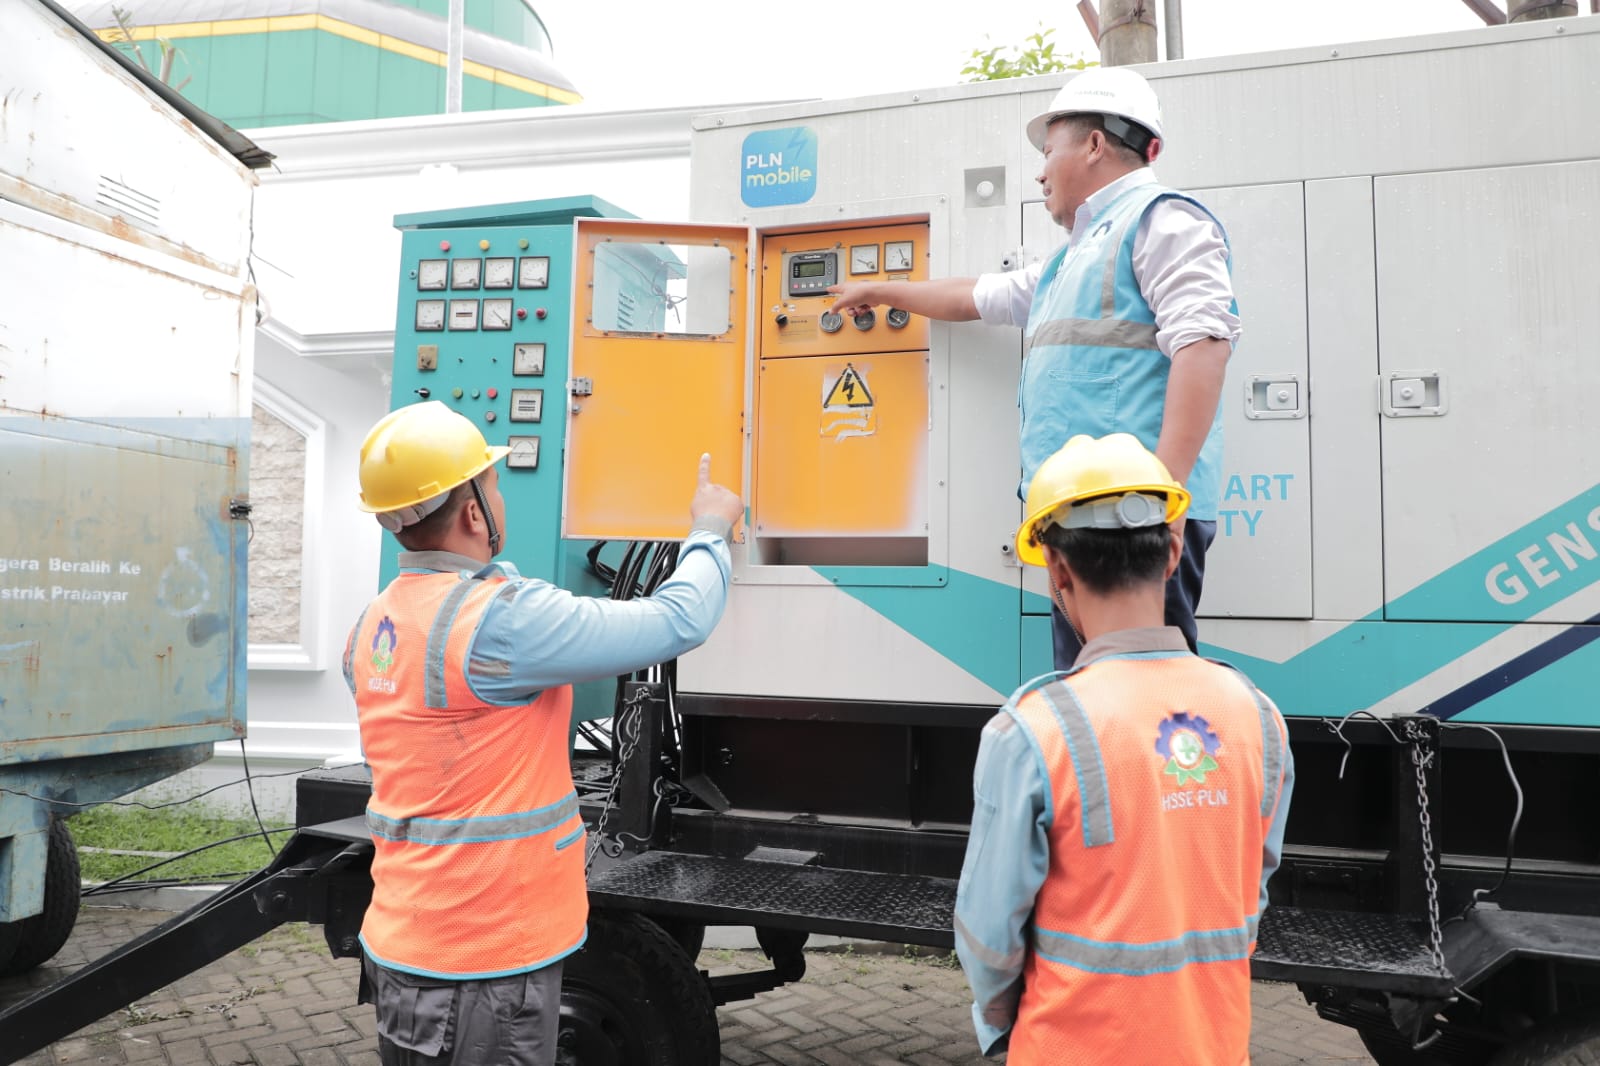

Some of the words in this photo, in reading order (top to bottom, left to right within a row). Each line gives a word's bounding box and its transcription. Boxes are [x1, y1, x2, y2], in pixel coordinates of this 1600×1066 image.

[746, 151, 783, 169] PLN
[746, 165, 812, 188] mobile
[1218, 473, 1294, 501] ART
[1218, 510, 1264, 537] TY
[49, 557, 111, 574] Beralih
[119, 560, 141, 575] Ke
[0, 585, 45, 600] strik
[51, 585, 129, 605] Prabayar
[1162, 790, 1194, 811] HSSE
[1197, 789, 1229, 807] PLN
